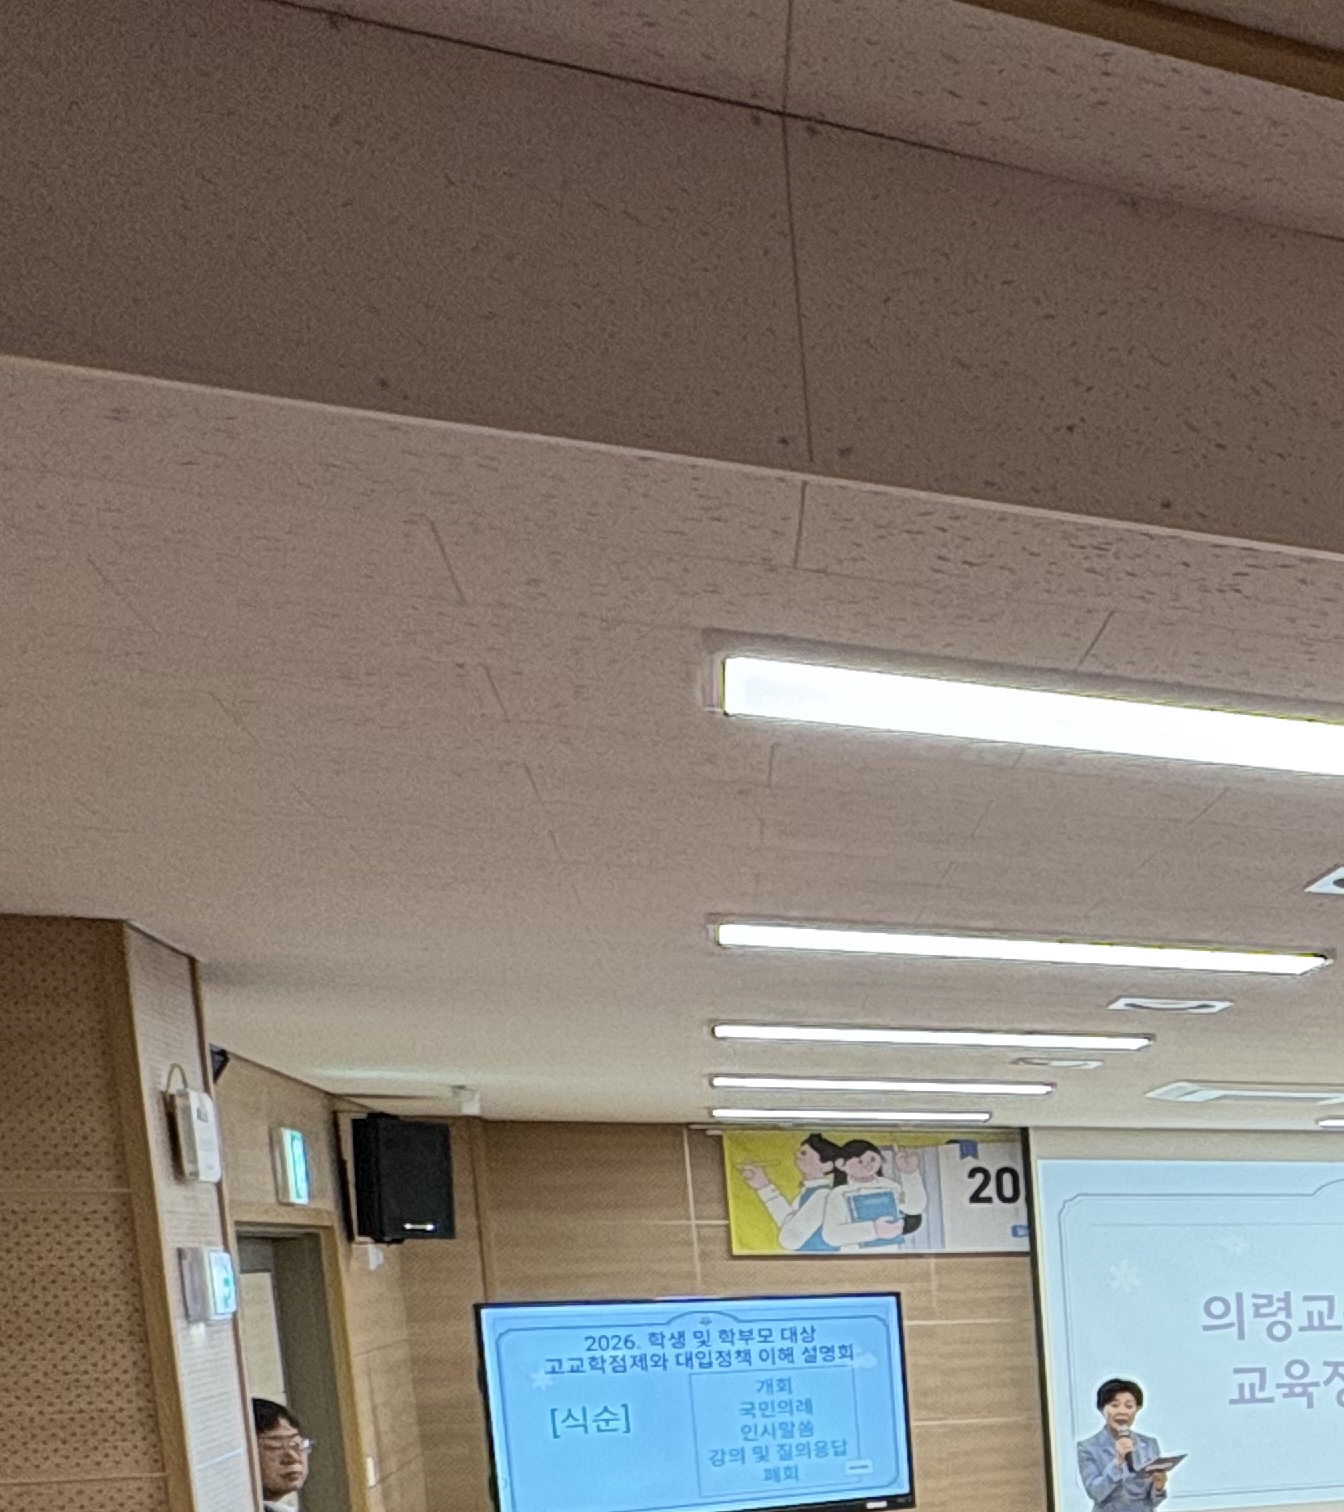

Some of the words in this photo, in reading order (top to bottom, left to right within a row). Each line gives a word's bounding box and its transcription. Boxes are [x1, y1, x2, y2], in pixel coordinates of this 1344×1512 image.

[967, 1166, 1021, 1204] 20
[584, 1334, 641, 1351] 2026.
[648, 1330, 686, 1349] 학생
[693, 1329, 712, 1349] 및
[718, 1328, 774, 1347] 학부모
[781, 1325, 816, 1343] 대상
[545, 1354, 668, 1374] 고교학점제와
[676, 1349, 752, 1369] 대입정책
[760, 1347, 796, 1365] 이해
[802, 1344, 854, 1363] 설명회
[757, 1376, 792, 1394] 개회
[550, 1403, 631, 1439] [식순]
[739, 1398, 813, 1418] 국민의례
[741, 1420, 814, 1441] 인사말씀
[709, 1447, 745, 1467] 강의
[752, 1445, 769, 1463] 및
[776, 1439, 847, 1461] 질의응답
